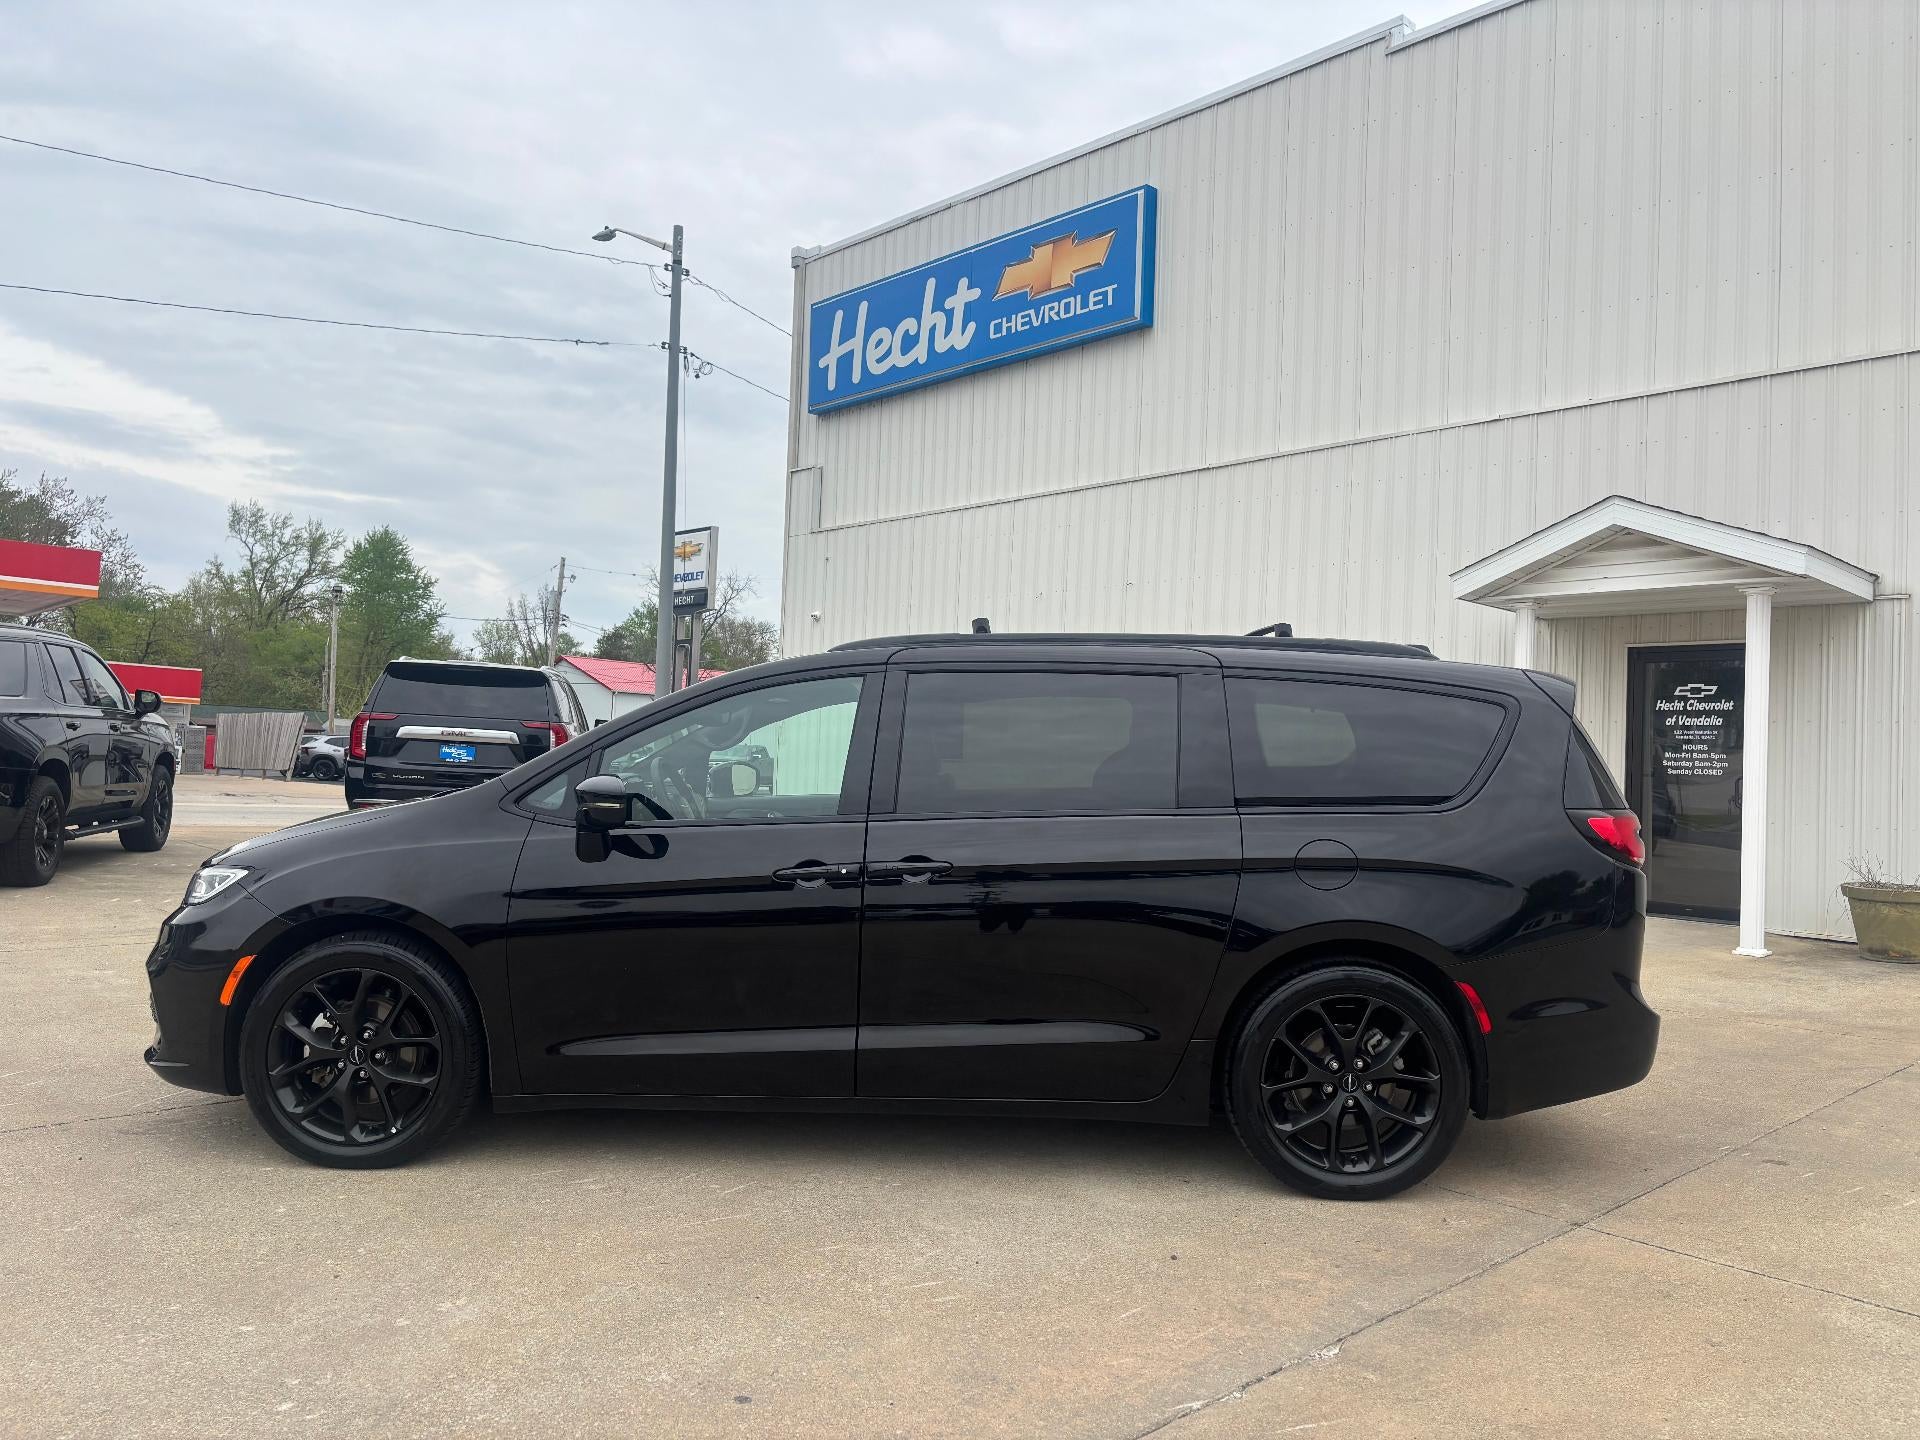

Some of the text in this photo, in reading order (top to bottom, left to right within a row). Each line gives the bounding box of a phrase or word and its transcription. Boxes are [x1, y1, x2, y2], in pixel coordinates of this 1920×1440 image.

[989, 284, 1118, 340] CHEVROLET
[818, 276, 982, 392] Hecht
[674, 595, 695, 606] HECHT
[1655, 699, 1734, 710] Hecht Chevrolet
[1665, 715, 1723, 726] of Vandalia
[1664, 751, 1727, 760] Mon-Fri 8am-5pm
[1662, 759, 1729, 768] Saturday 8am-2pm
[1667, 768, 1723, 776] Sunday CLOSED
